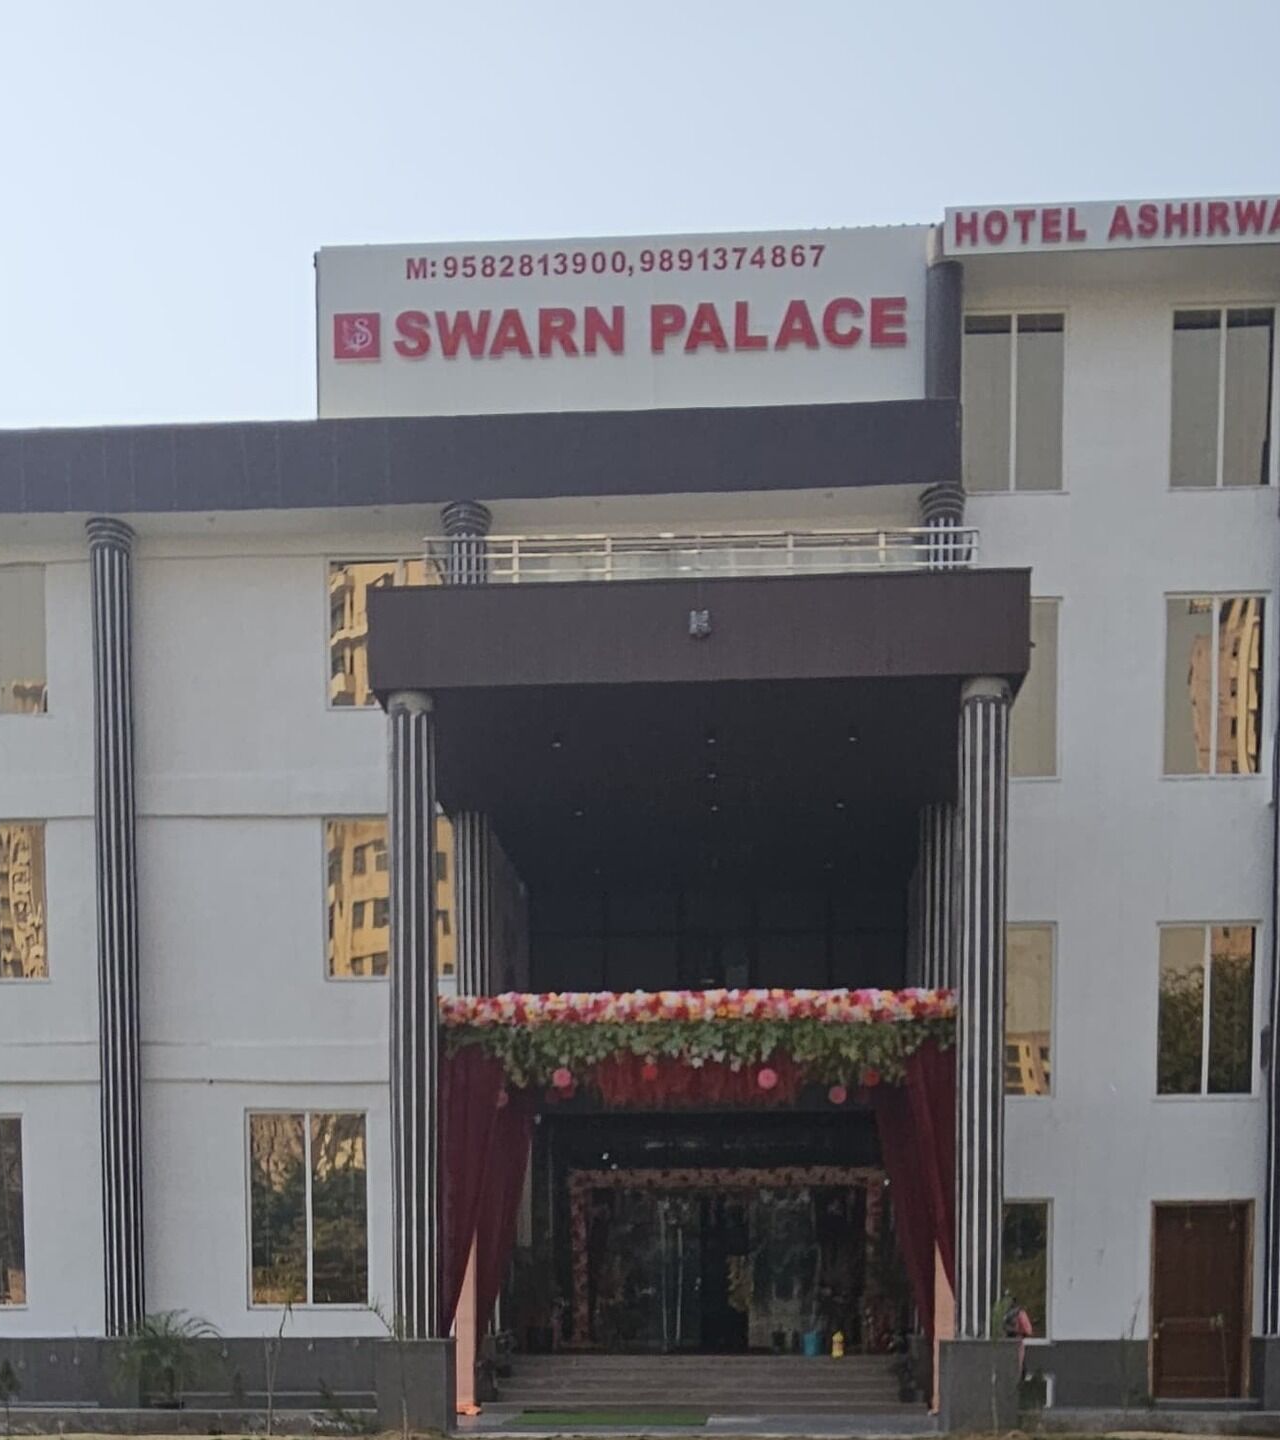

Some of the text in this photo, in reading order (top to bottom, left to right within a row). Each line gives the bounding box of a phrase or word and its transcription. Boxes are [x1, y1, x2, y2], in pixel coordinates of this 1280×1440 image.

[954, 207, 1086, 245] HOTEL
[393, 297, 908, 360] SWARN PALACE
